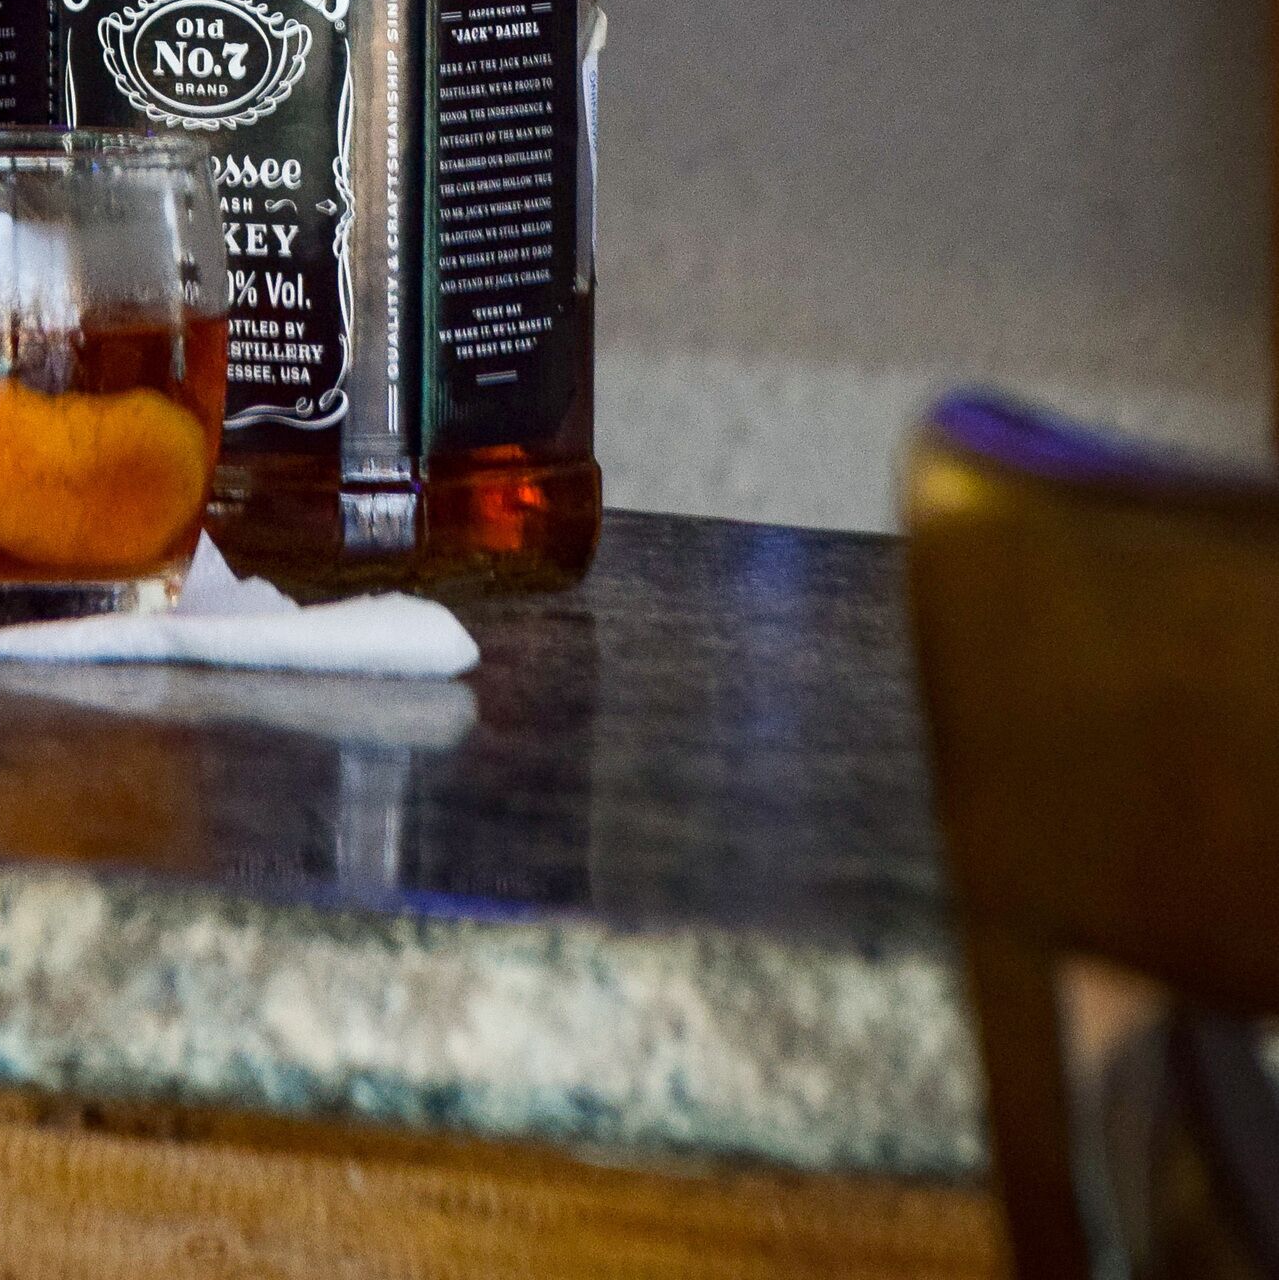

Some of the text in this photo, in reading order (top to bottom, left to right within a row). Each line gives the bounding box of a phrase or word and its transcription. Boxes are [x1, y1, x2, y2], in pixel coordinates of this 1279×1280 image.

[176, 18, 224, 39] Old
[496, 21, 540, 40] DANIEL
[153, 40, 249, 79] No.7
[466, 60, 477, 72] AT
[479, 59, 496, 71] THE
[499, 56, 520, 71] JACK
[523, 52, 552, 65] DANIEL
[175, 82, 229, 96] BRAND
[542, 77, 552, 87] TO
[498, 129, 513, 140] THE
[387, 49, 399, 248] CRAFTSMANSHIP
[219, 197, 254, 215] ASH
[387, 254, 399, 272] &
[265, 271, 312, 310] Vol.
[229, 319, 305, 342] TTLED BY
[387, 278, 399, 380] QUALITY
[228, 342, 324, 364] STILLERY
[227, 363, 312, 385] ESSEE, USA
